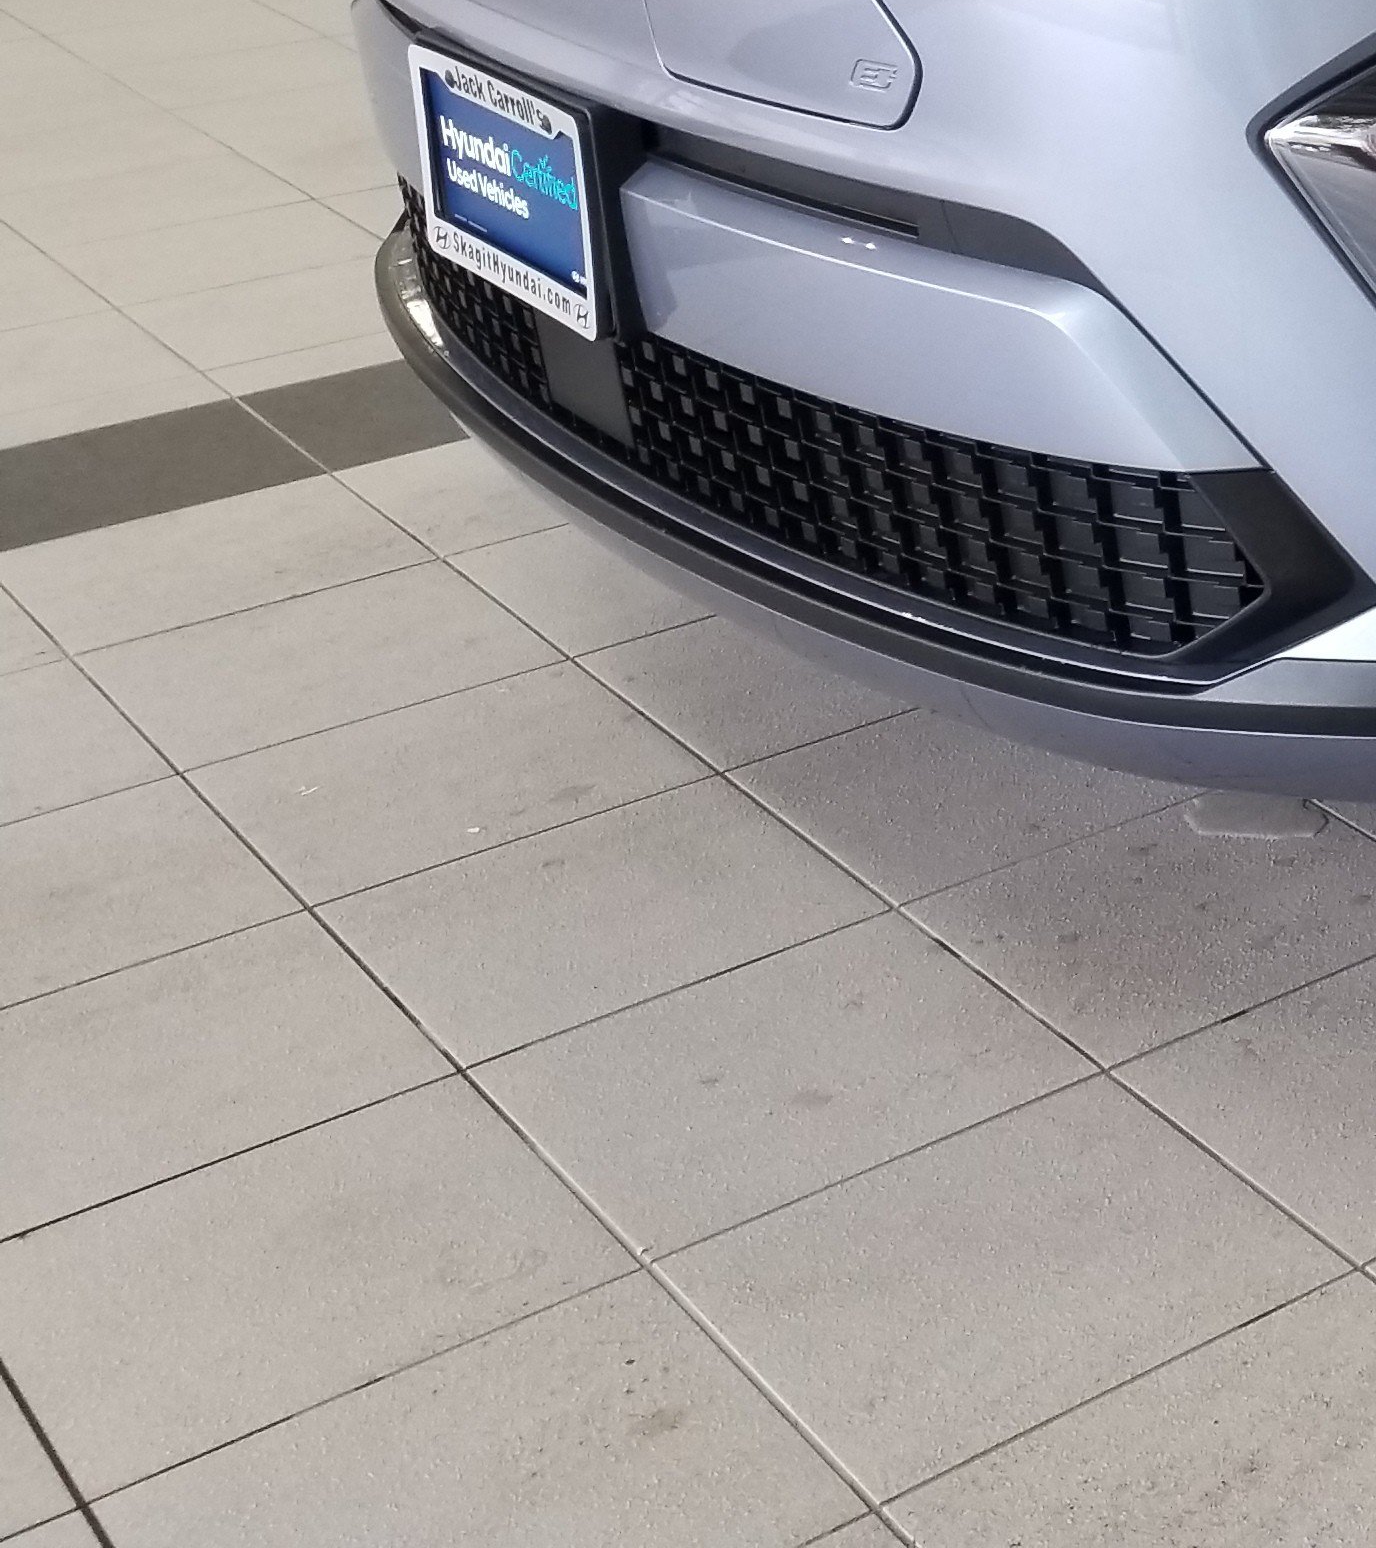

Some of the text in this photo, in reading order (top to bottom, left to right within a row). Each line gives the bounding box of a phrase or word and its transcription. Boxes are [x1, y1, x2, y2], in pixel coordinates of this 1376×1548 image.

[453, 65, 486, 102] Jack
[440, 114, 577, 211] Hyundai Certified
[446, 157, 530, 220] Used Vehicles
[453, 231, 571, 316] SkagitHyundai.com
